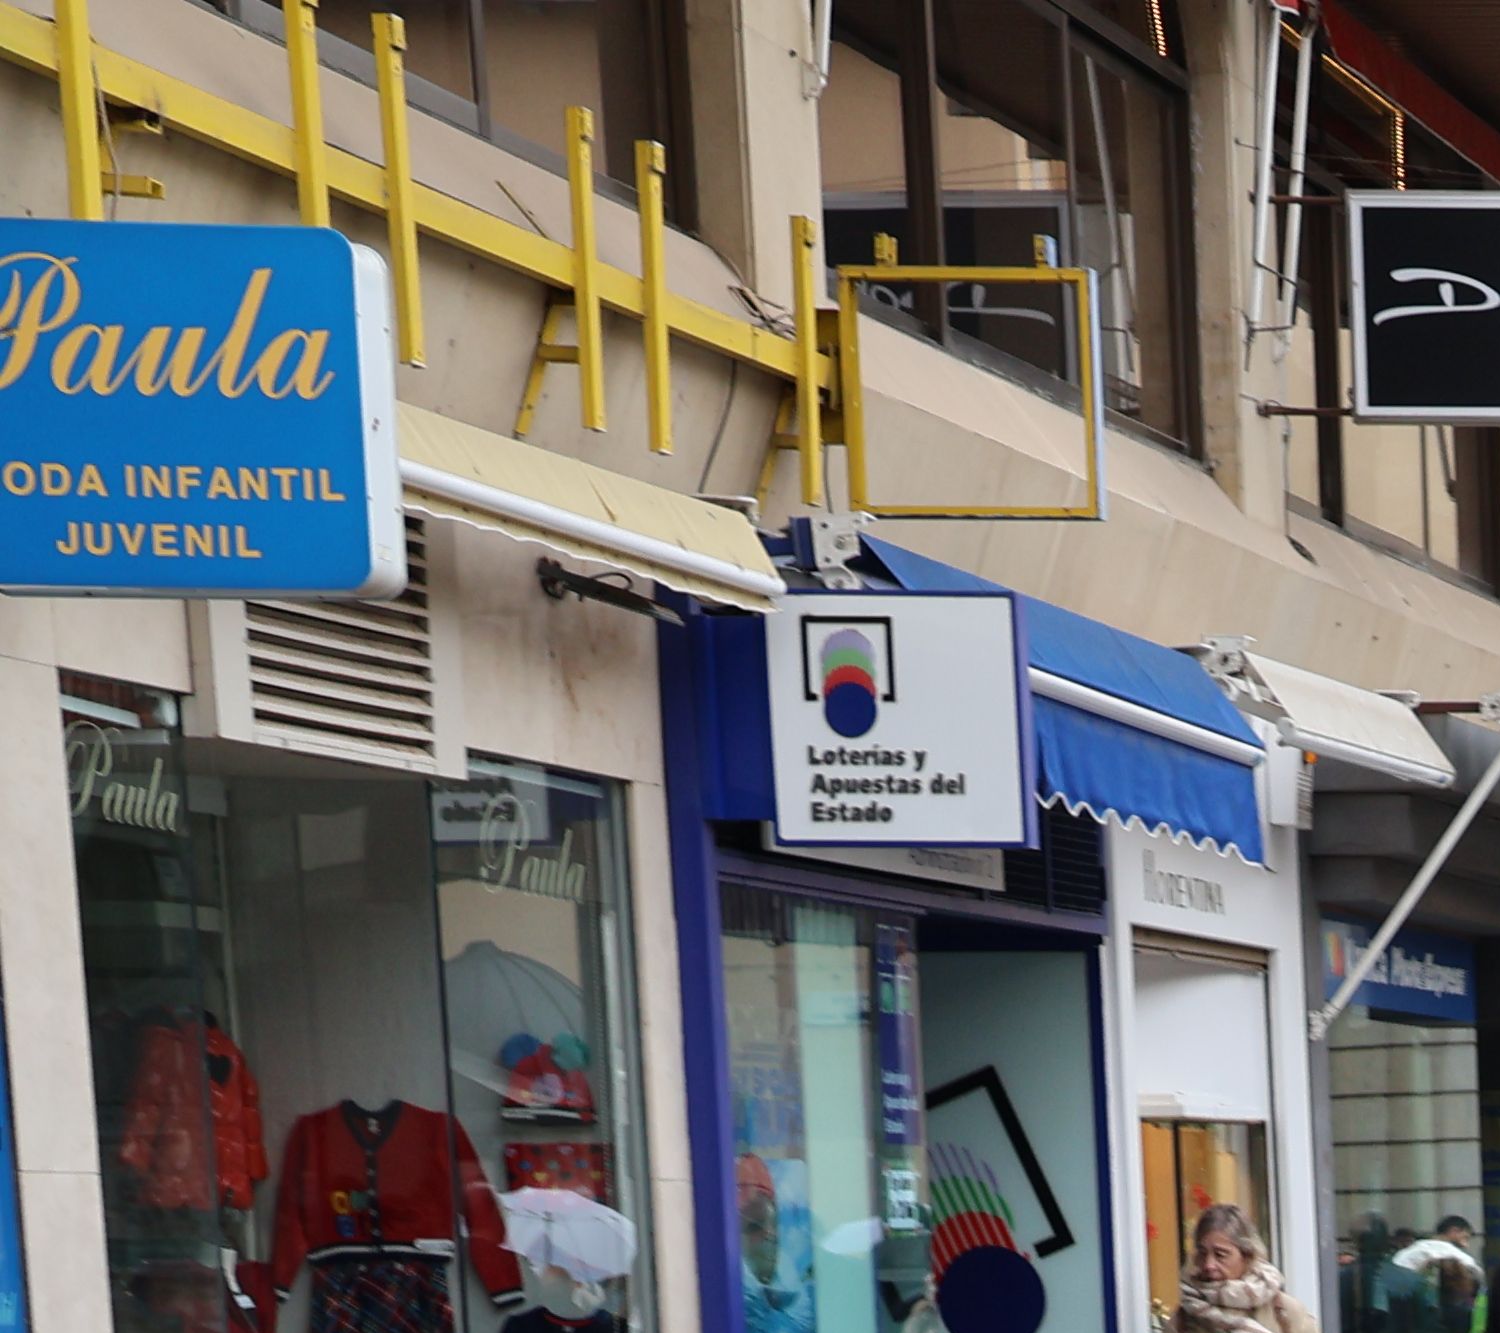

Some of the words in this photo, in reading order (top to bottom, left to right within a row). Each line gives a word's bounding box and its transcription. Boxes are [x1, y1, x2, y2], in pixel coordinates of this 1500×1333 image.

[0, 251, 336, 400] Paula
[2, 460, 109, 498] ODA
[124, 464, 347, 502] INFANTIL
[55, 521, 264, 559] JUVENIL
[914, 750, 926, 771] y
[811, 773, 922, 798] Apuestas
[930, 773, 966, 795] del
[811, 801, 893, 823] Estado
[479, 792, 586, 903] Paula
